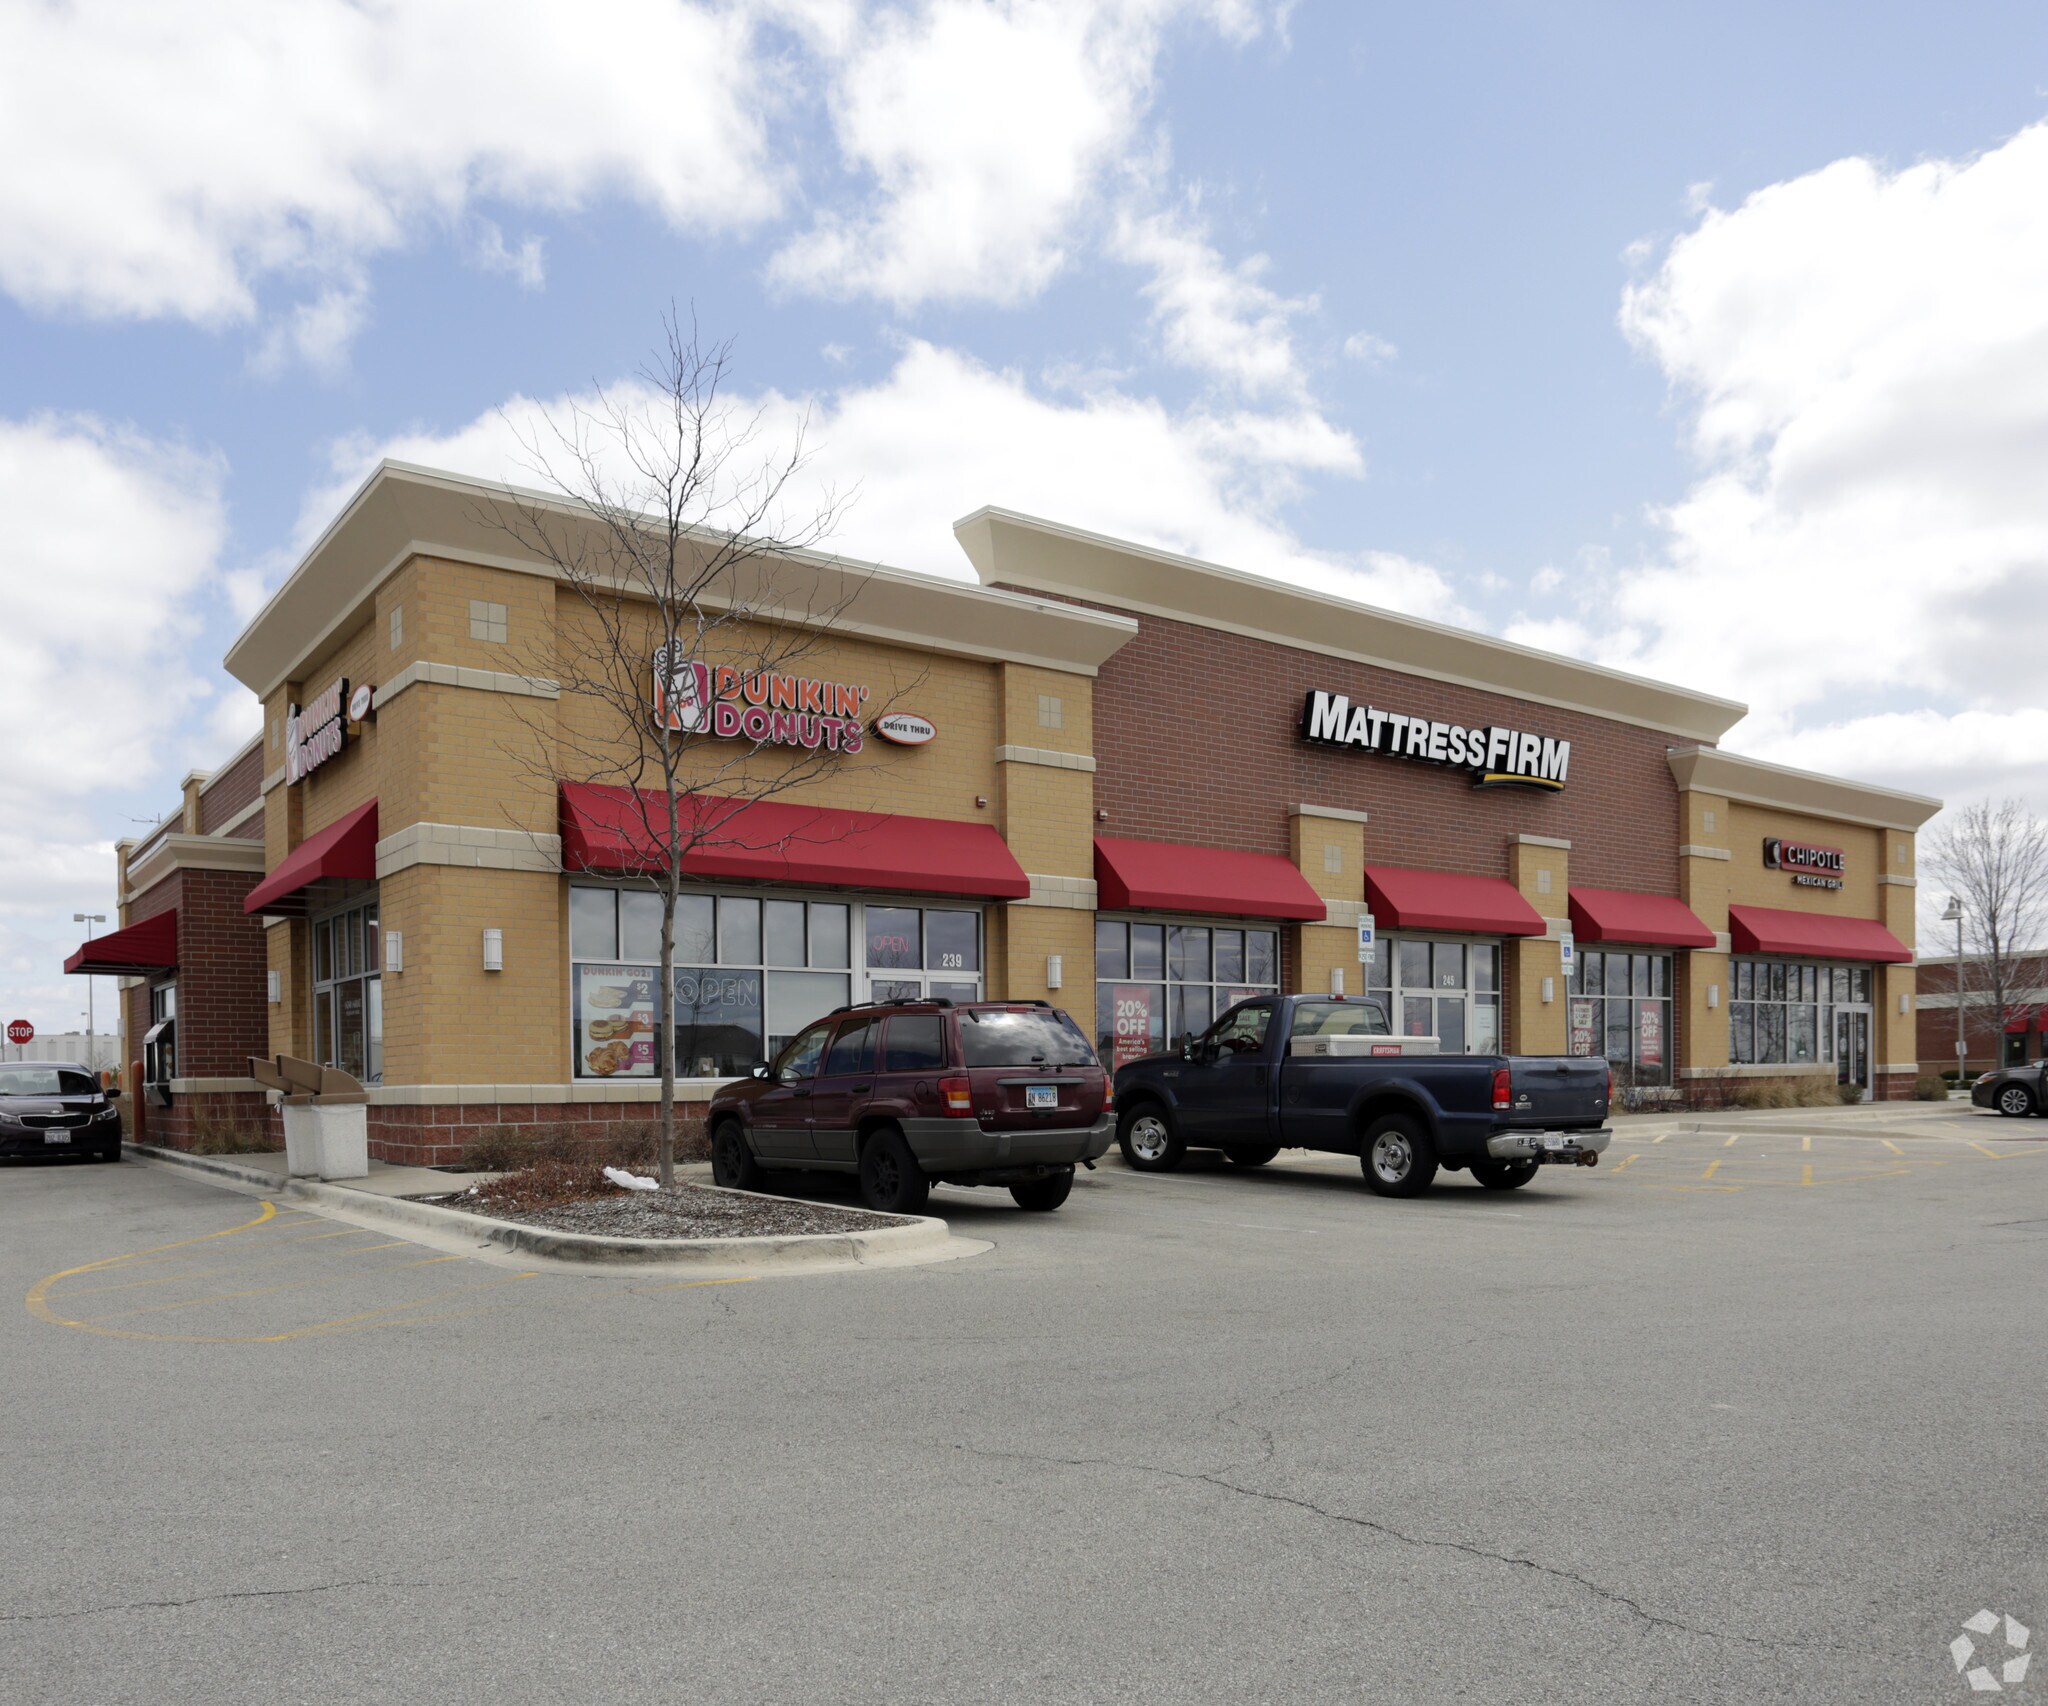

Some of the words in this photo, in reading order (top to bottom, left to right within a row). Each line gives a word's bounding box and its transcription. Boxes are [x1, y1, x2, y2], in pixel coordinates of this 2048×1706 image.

[714, 664, 869, 718] DUNKIN'
[714, 701, 864, 754] DONUTS
[883, 720, 908, 732] DRIVE
[910, 725, 931, 735] THRU
[1788, 846, 1845, 870] CHIPOTLE
[1797, 875, 1826, 887] MEXICAN
[873, 935, 909, 952] OPEN
[942, 953, 962, 968] 239
[1443, 975, 1454, 986] 245
[636, 982, 649, 994] $2
[674, 976, 758, 1007] OPEN
[1116, 1000, 1148, 1018] 20%
[637, 1012, 649, 1025] $3
[1641, 1011, 1659, 1025] 20%
[8, 1027, 33, 1037] STOP
[1116, 1018, 1146, 1036] OFF
[1641, 1025, 1658, 1038] OFF
[1118, 1038, 1145, 1046] America's
[1574, 1030, 1591, 1043] 20%
[637, 1043, 649, 1056] $5
[1129, 1046, 1148, 1054] selling
[1574, 1043, 1591, 1055] OFF
